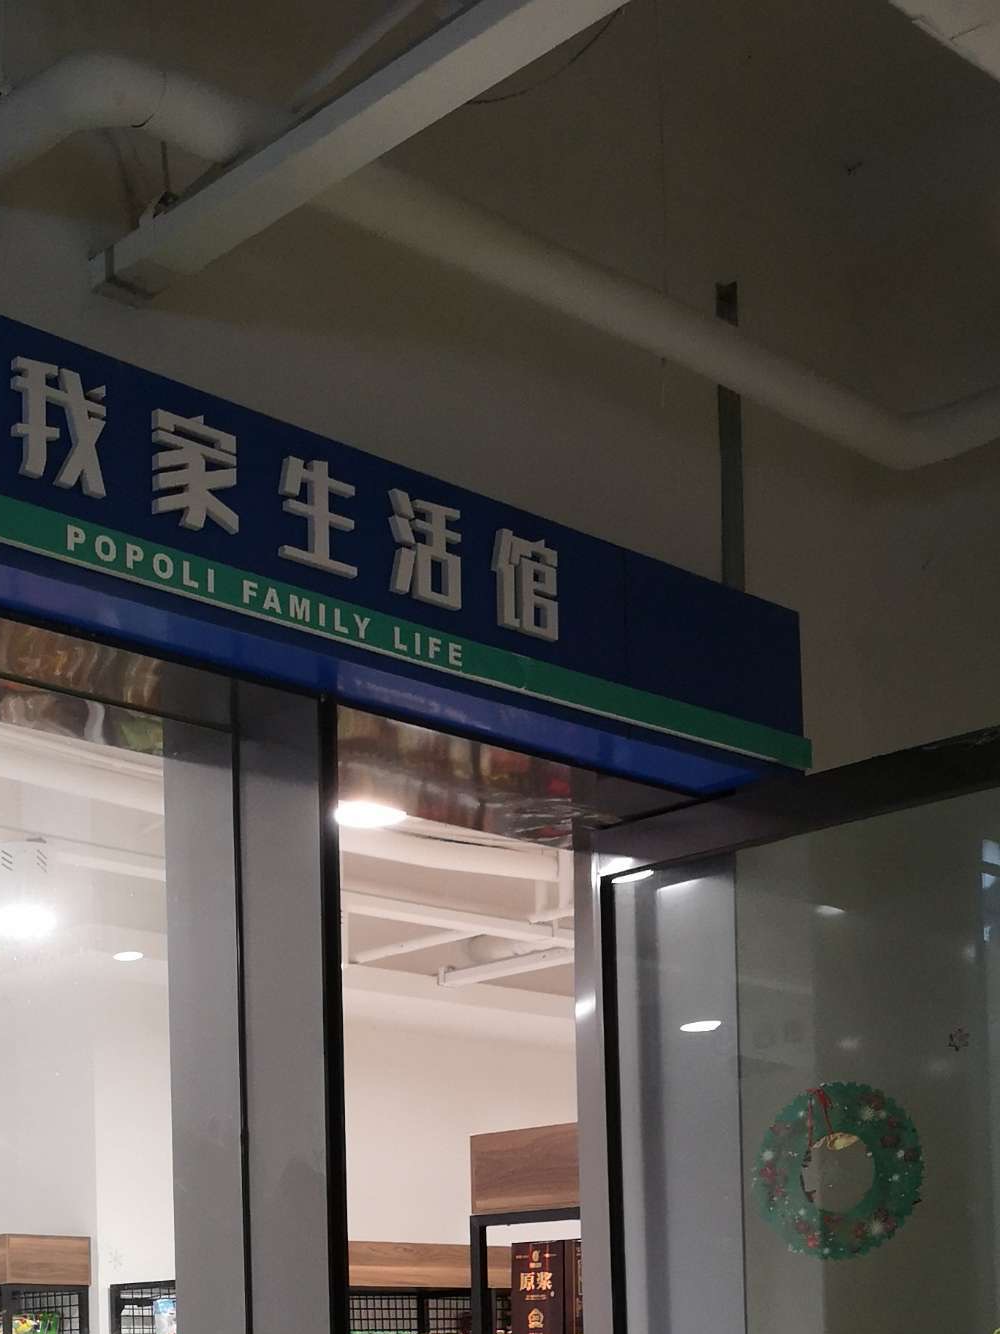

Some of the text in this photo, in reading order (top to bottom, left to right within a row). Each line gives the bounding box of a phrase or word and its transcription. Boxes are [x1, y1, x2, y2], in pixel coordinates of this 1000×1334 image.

[10, 355, 560, 643] 我家生活馆
[66, 523, 464, 669] POPOLI FAMILY LIFE
